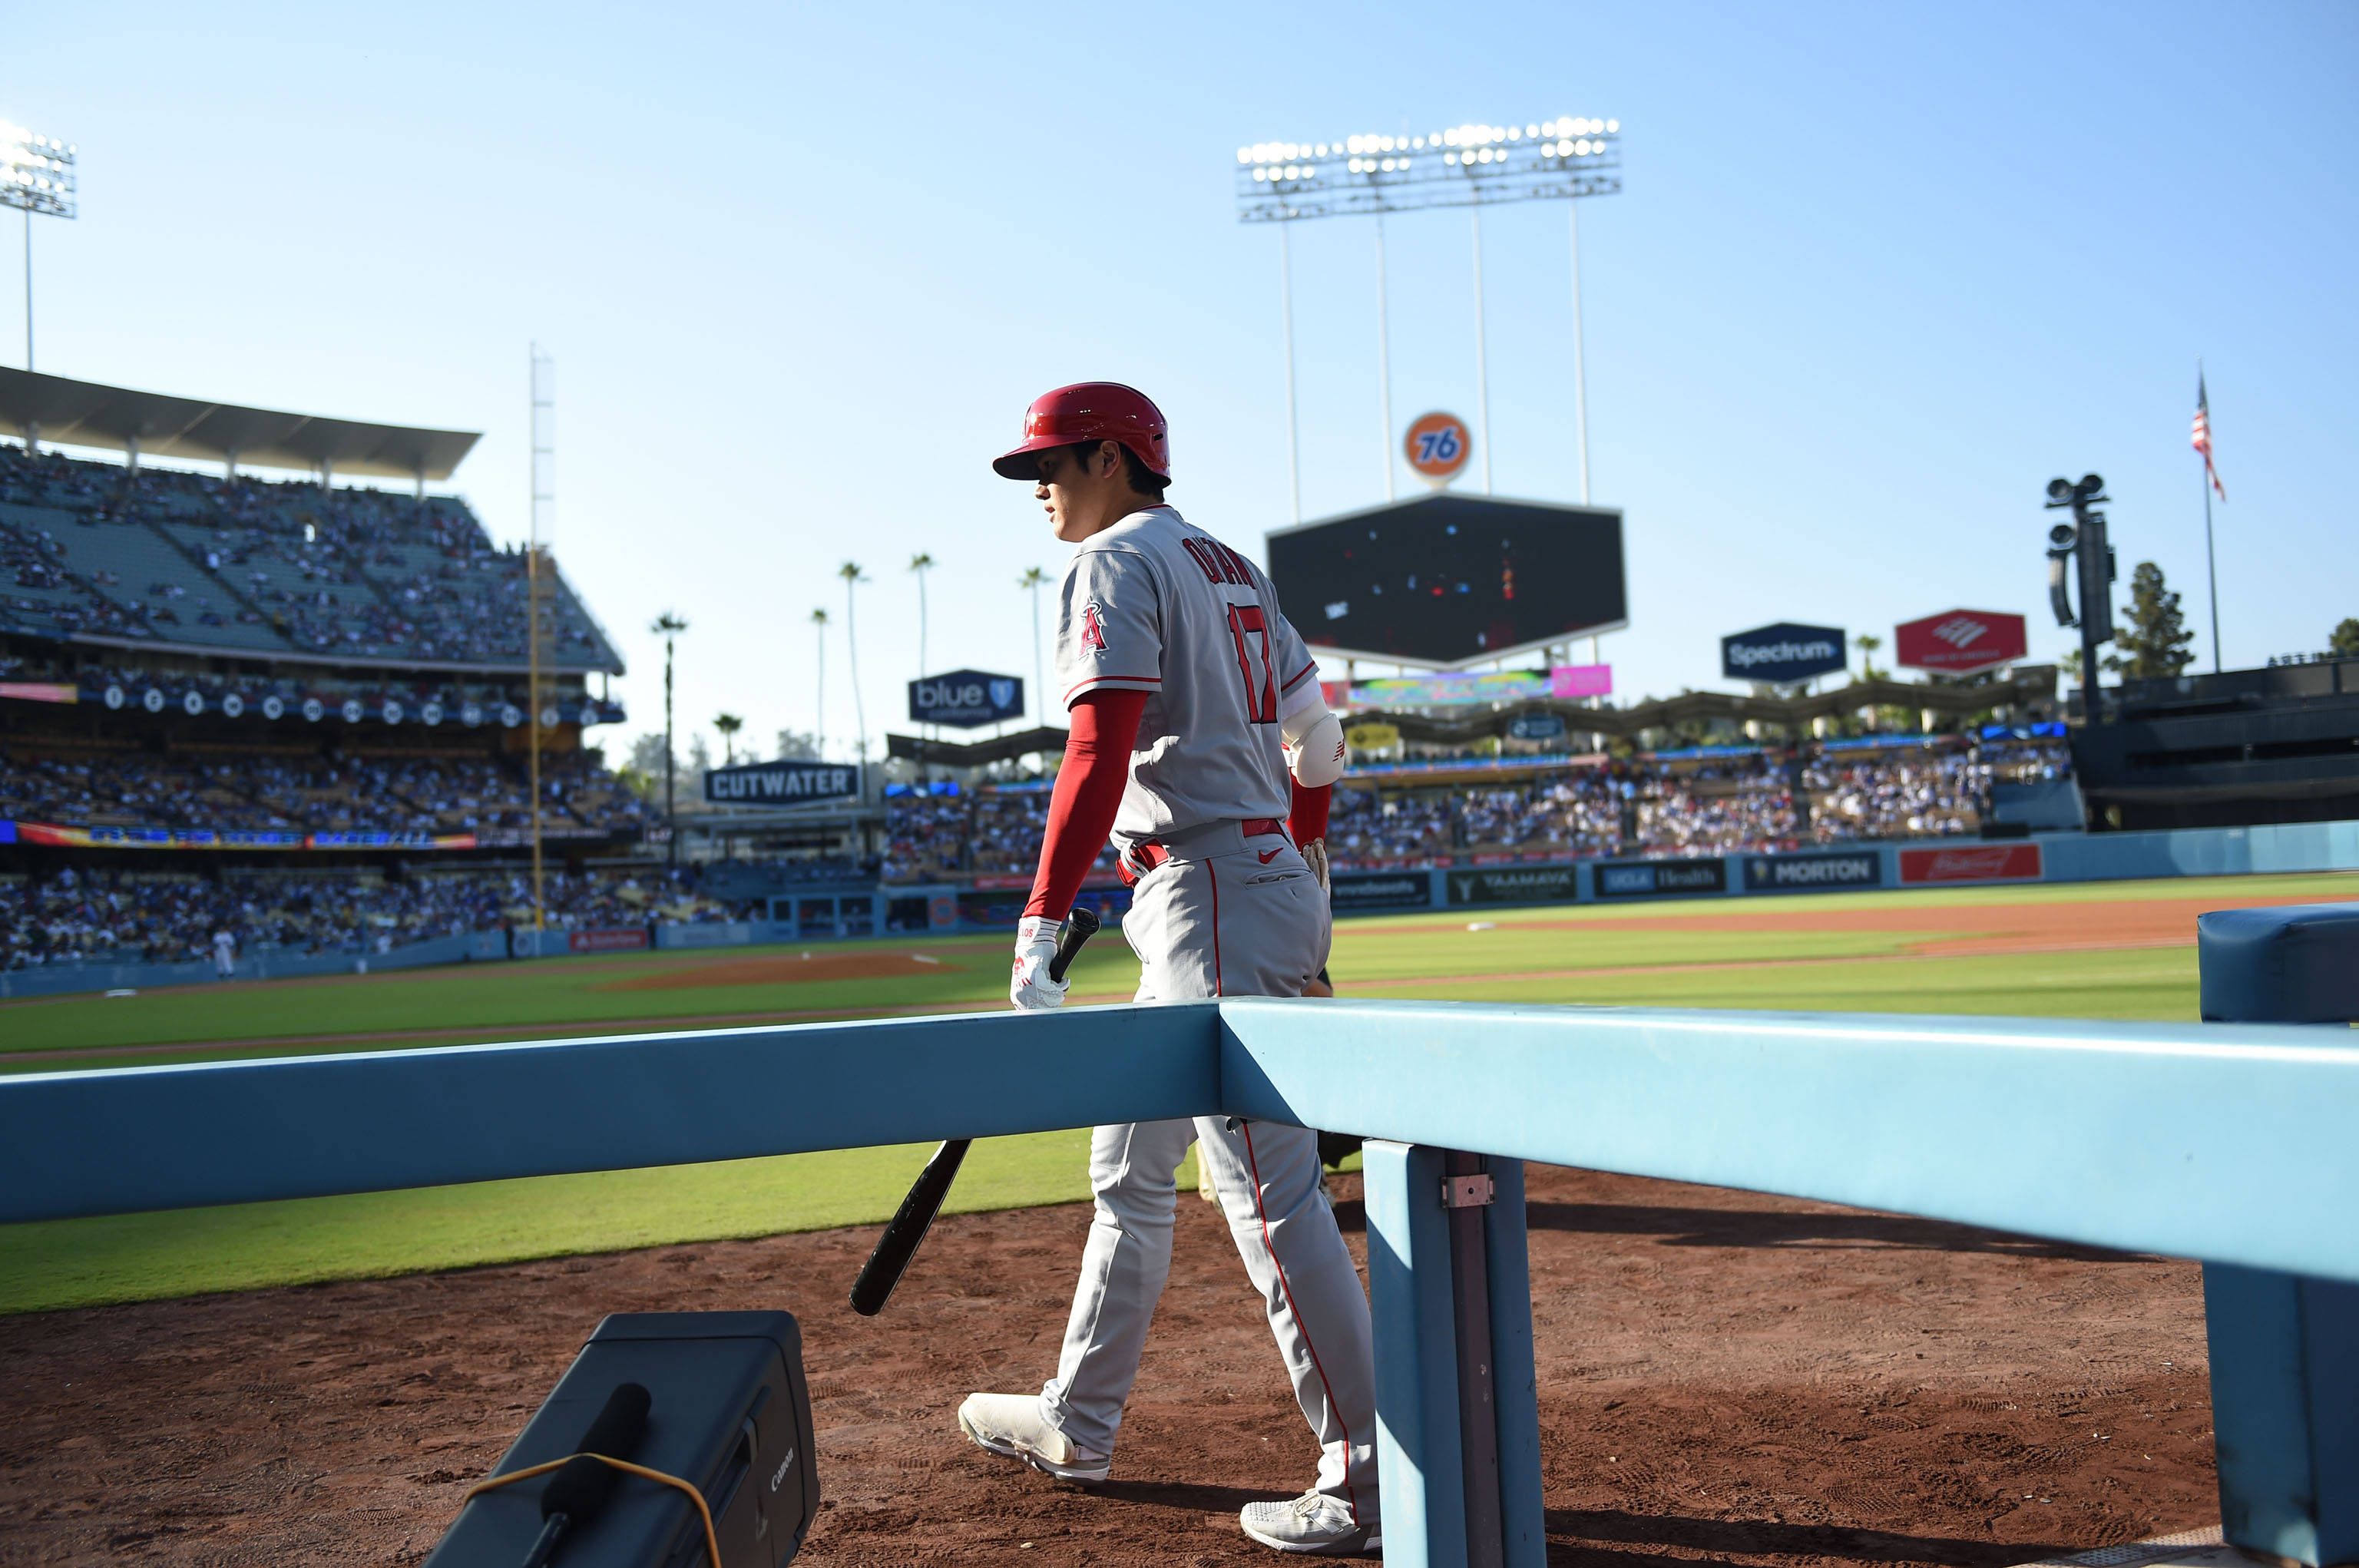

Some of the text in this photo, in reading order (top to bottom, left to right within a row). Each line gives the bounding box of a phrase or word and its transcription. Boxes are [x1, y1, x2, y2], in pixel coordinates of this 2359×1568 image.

[1415, 425, 1462, 463] 76
[1227, 602, 1278, 724] 17
[1729, 641, 1832, 669] Spectrum
[917, 680, 984, 707] blue
[713, 769, 848, 798] CUTWATER
[1658, 867, 1715, 886] Health
[1775, 852, 1869, 882] MORTON
[771, 1447, 794, 1492] Canon
